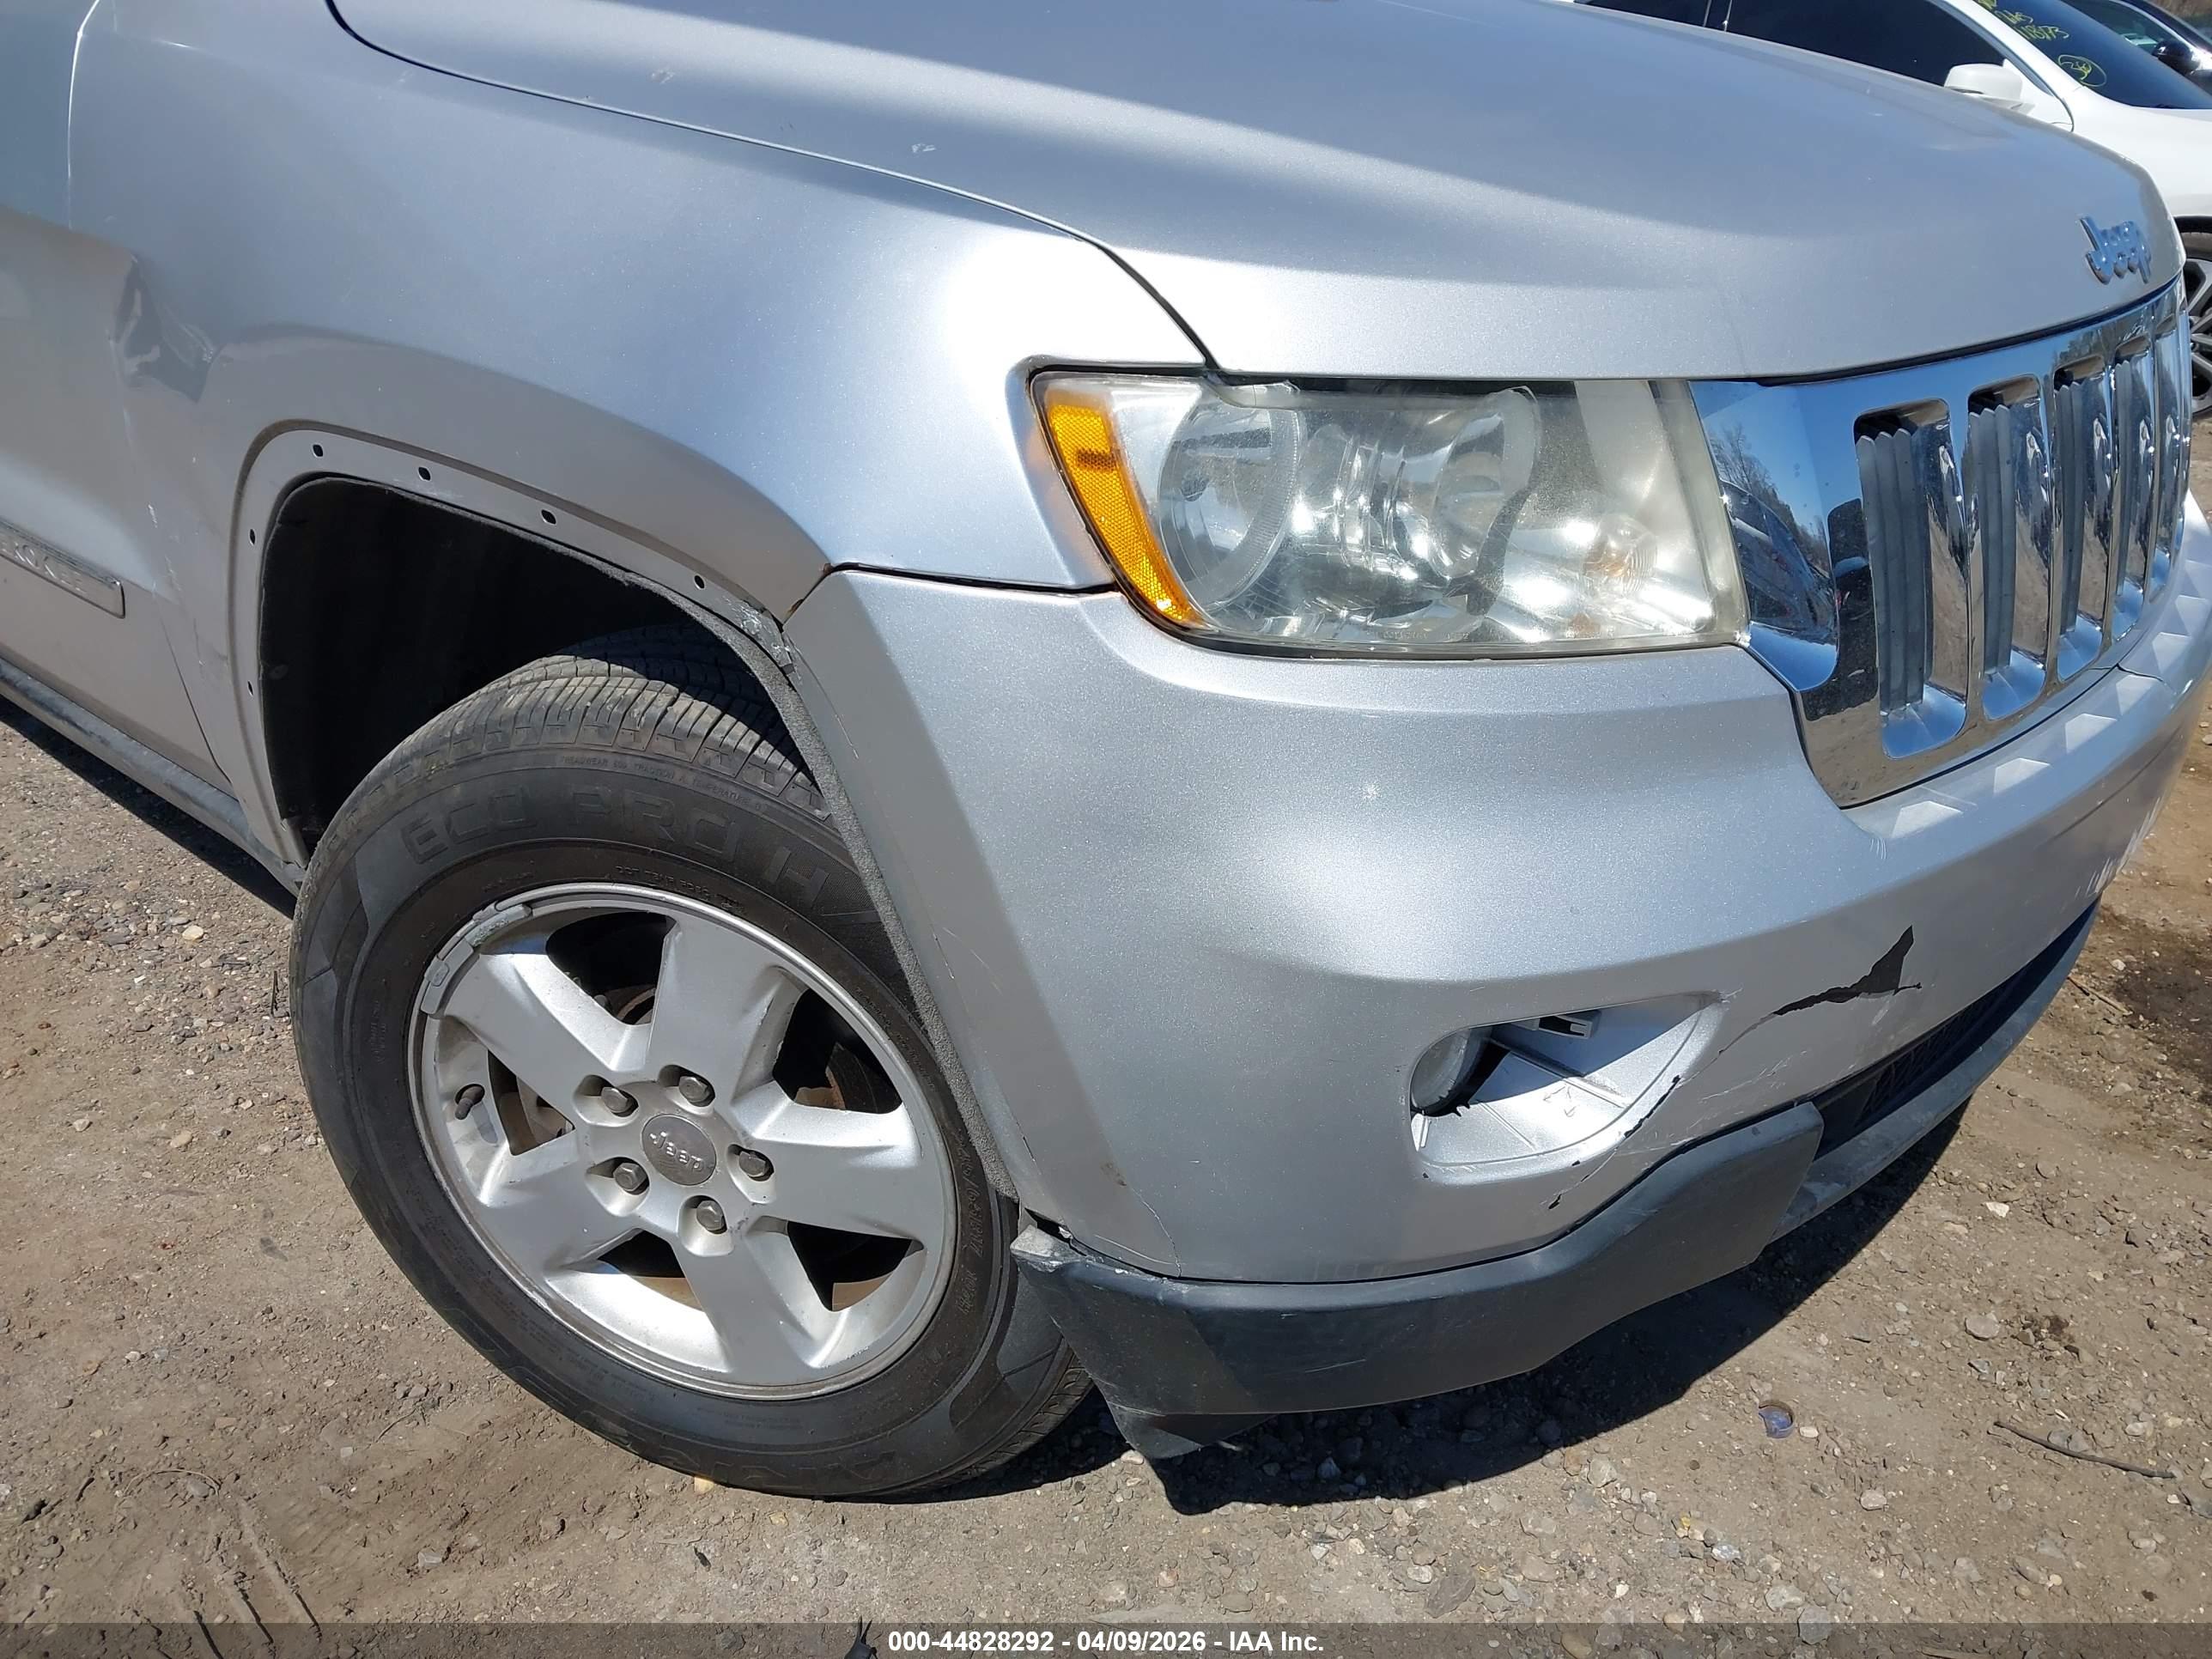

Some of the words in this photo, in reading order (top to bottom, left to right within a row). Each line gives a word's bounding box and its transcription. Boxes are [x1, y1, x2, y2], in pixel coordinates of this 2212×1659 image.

[2078, 215, 2153, 286] Jeep
[401, 784, 538, 864] ECO
[570, 783, 741, 859] PRO
